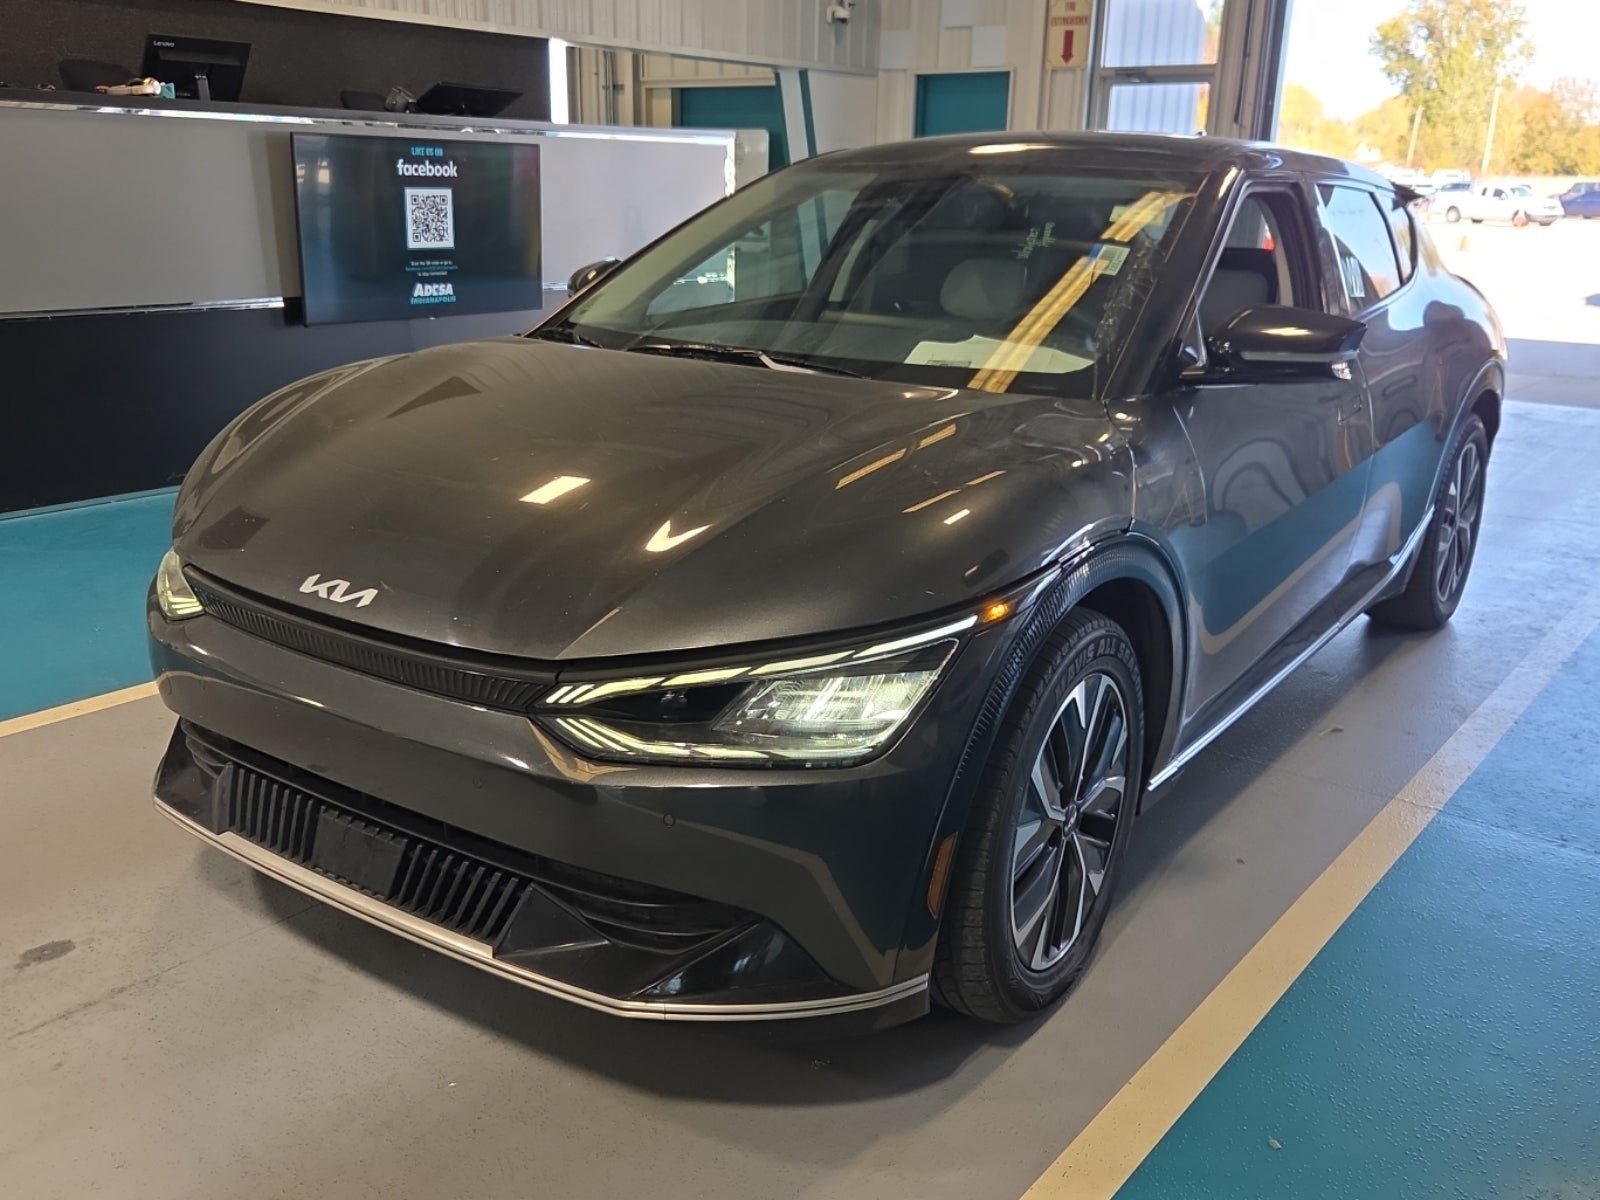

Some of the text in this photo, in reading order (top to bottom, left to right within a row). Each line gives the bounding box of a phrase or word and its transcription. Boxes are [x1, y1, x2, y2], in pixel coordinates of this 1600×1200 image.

[397, 159, 458, 177] facebook
[413, 283, 453, 297] ADESA
[299, 574, 378, 607] KIA
[1097, 638, 1118, 656] ALL
